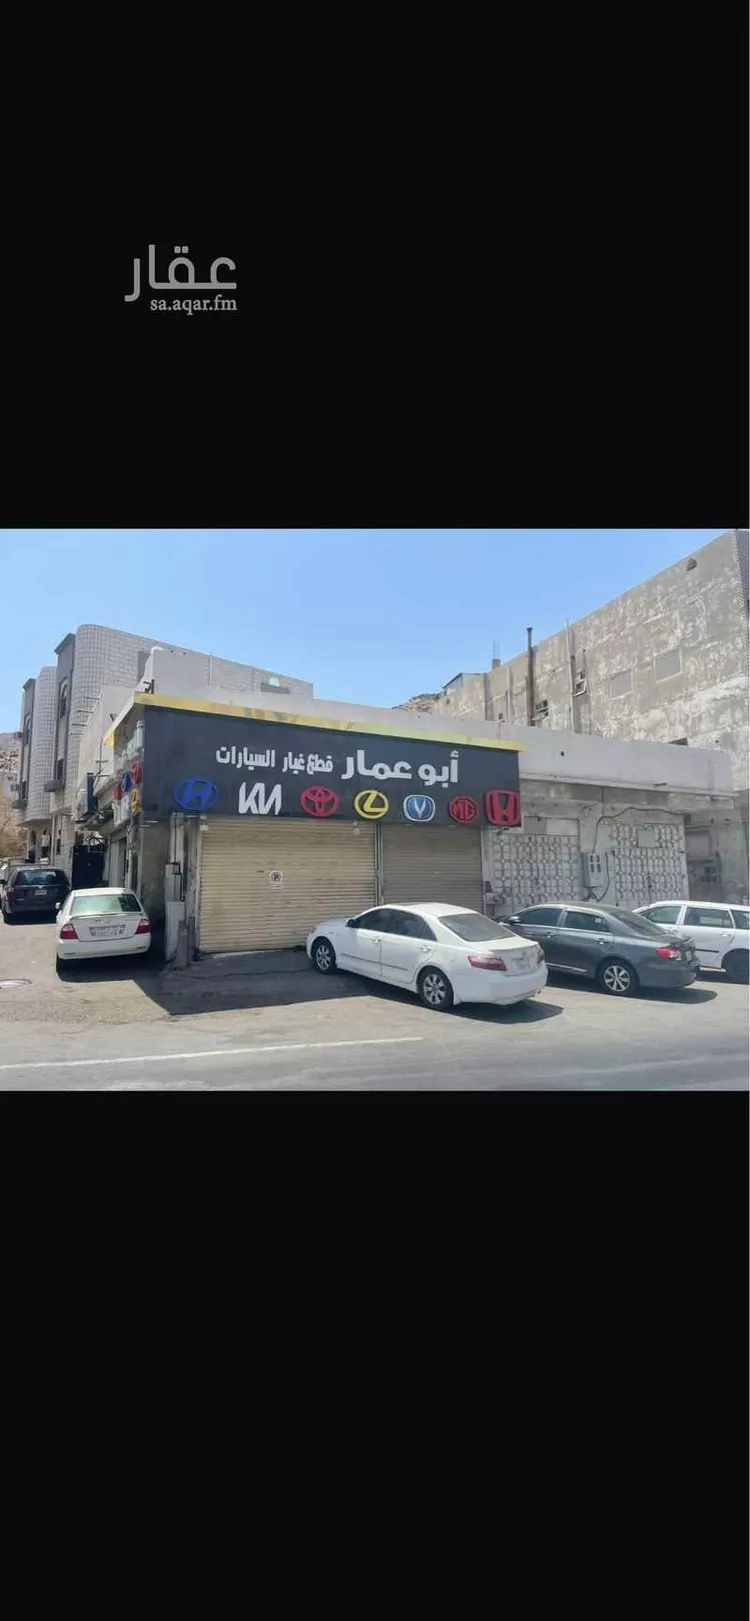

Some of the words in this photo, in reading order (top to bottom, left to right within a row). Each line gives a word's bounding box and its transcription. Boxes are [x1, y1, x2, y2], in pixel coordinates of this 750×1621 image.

[216, 745, 276, 771] السيارات
[282, 751, 305, 775] غيار
[306, 753, 334, 775] قطع
[341, 749, 412, 780] عمار
[417, 750, 460, 788] أبو
